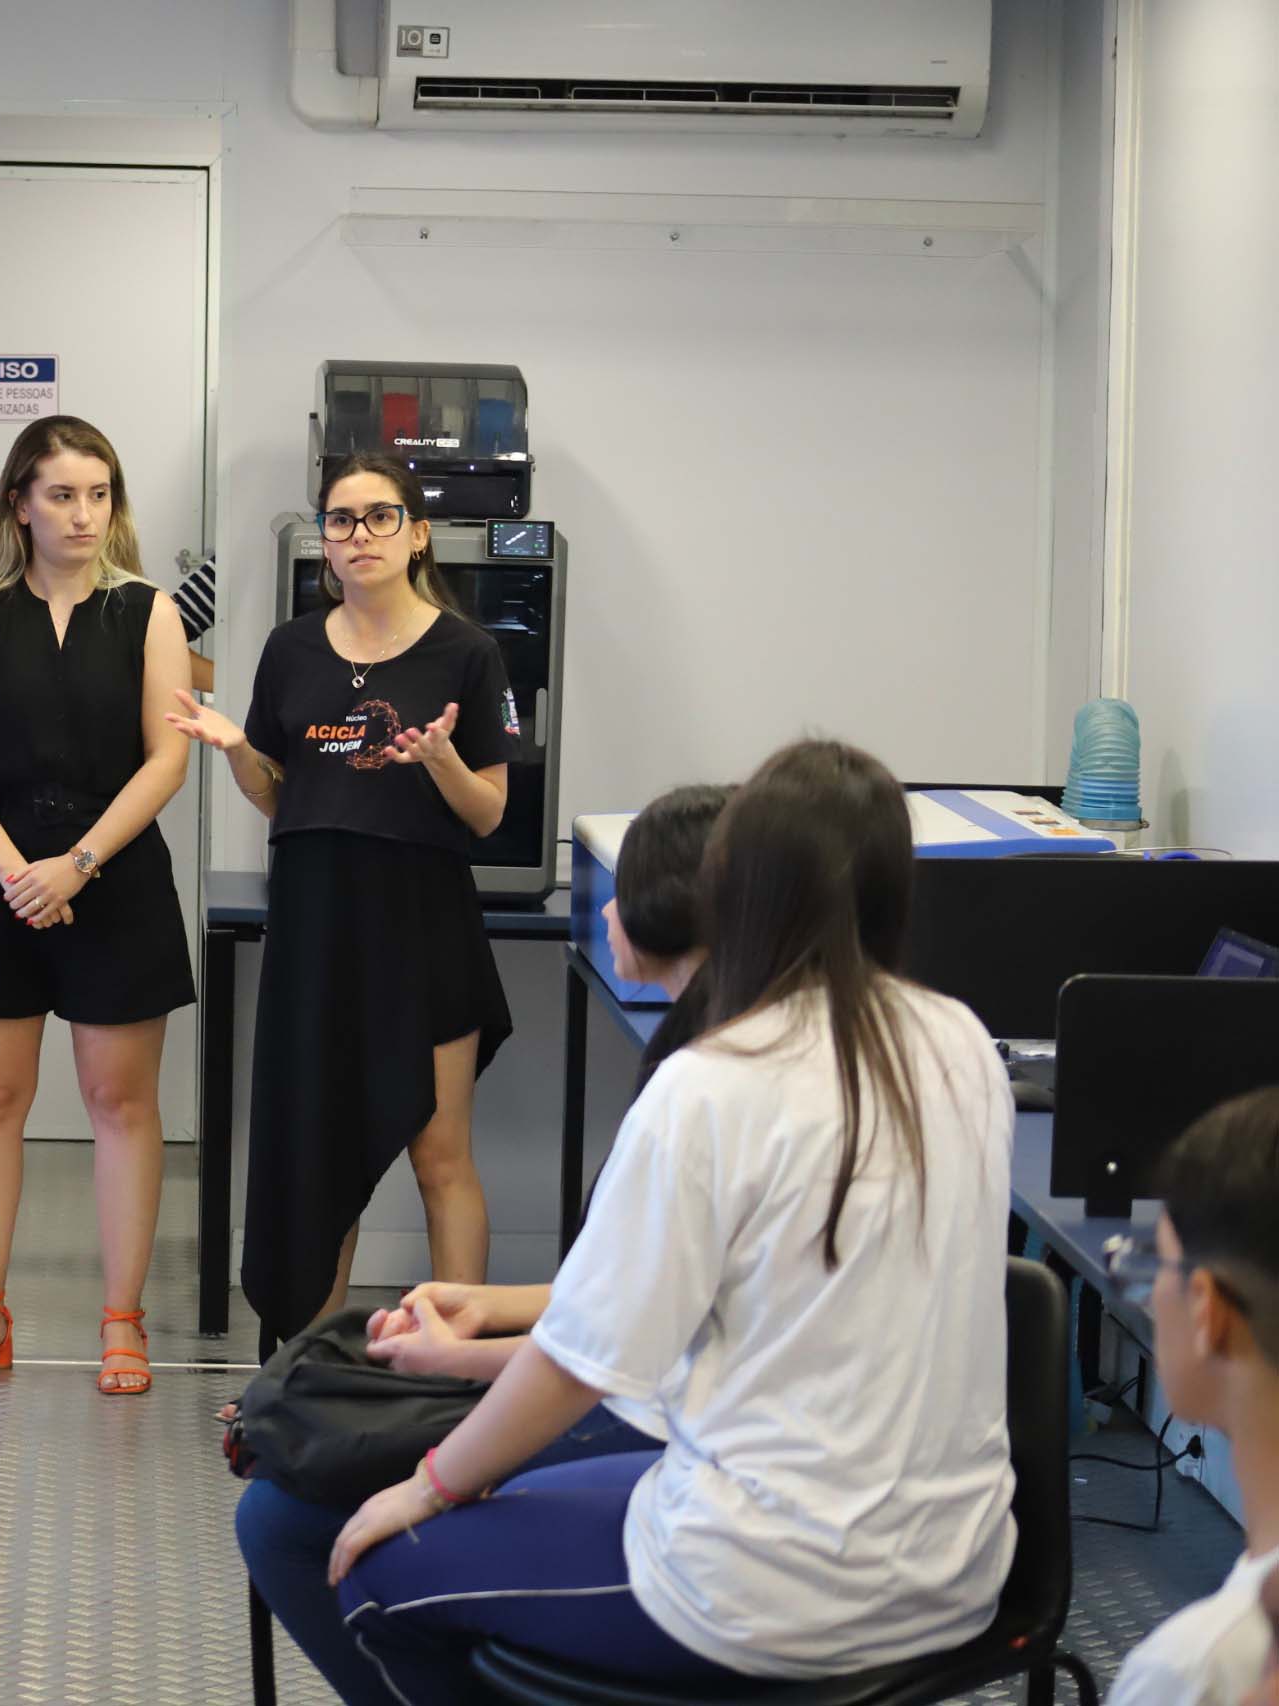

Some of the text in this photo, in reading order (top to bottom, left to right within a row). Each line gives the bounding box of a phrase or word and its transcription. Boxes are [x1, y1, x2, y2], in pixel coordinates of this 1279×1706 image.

[6, 387, 53, 399] PESSOAS
[394, 438, 435, 446] CREALITY
[305, 724, 366, 740] ACICLA
